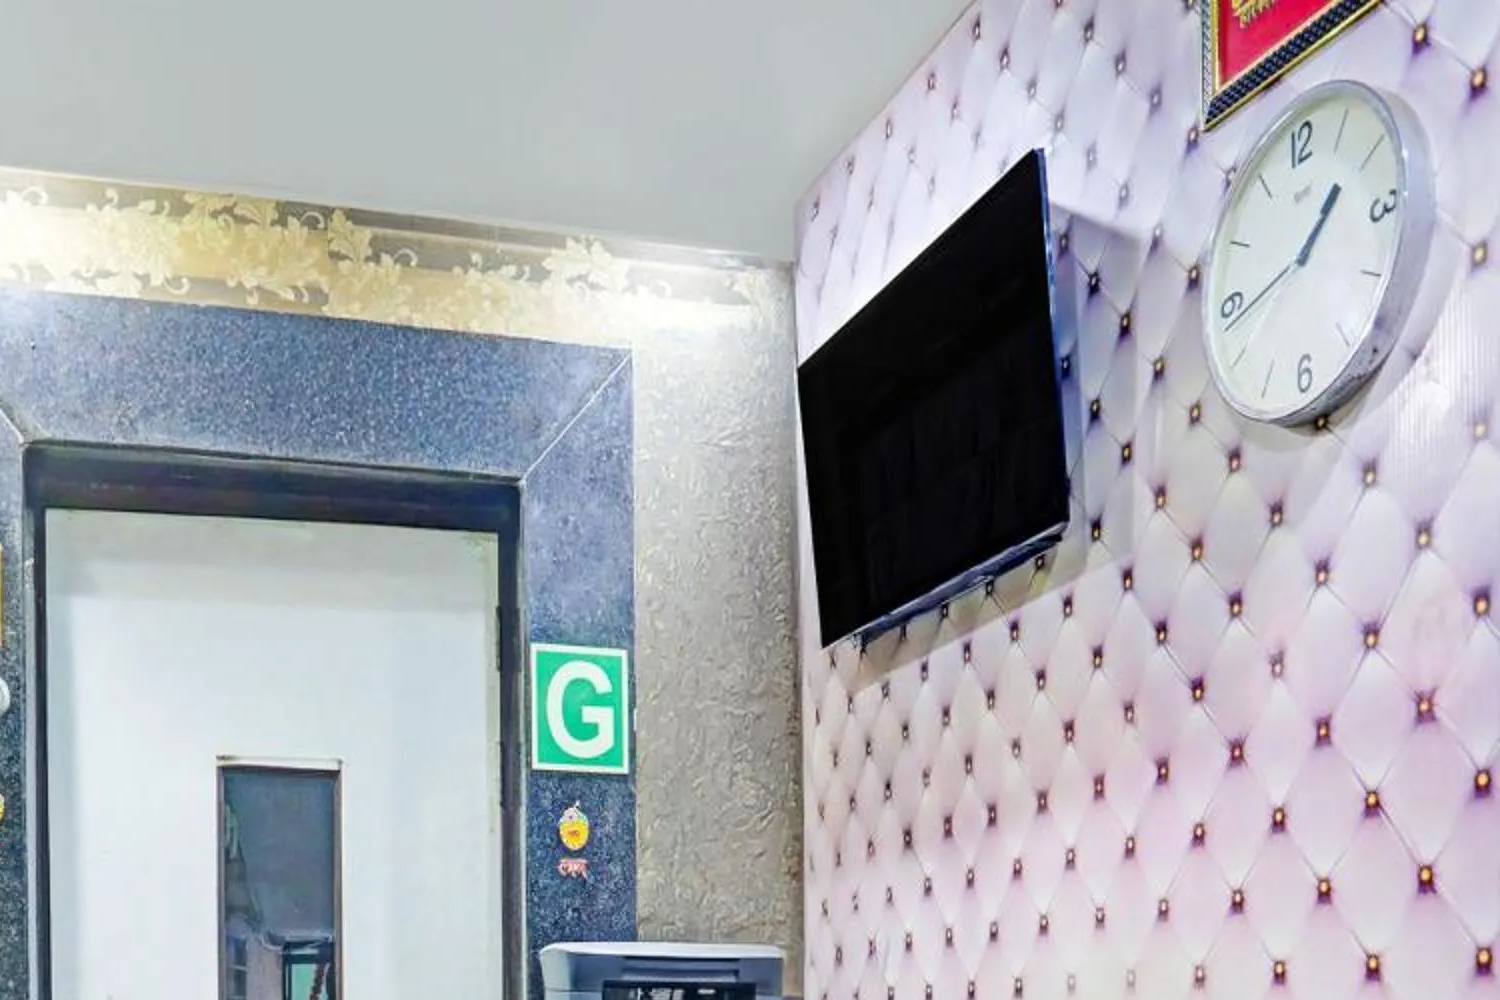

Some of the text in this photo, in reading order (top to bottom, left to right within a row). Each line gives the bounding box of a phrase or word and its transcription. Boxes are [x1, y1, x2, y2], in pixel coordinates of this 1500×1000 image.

[1290, 120, 1314, 170] 12
[1368, 188, 1398, 224] 3
[1220, 291, 1245, 319] 9
[1296, 353, 1313, 394] 6
[545, 659, 616, 760] G
